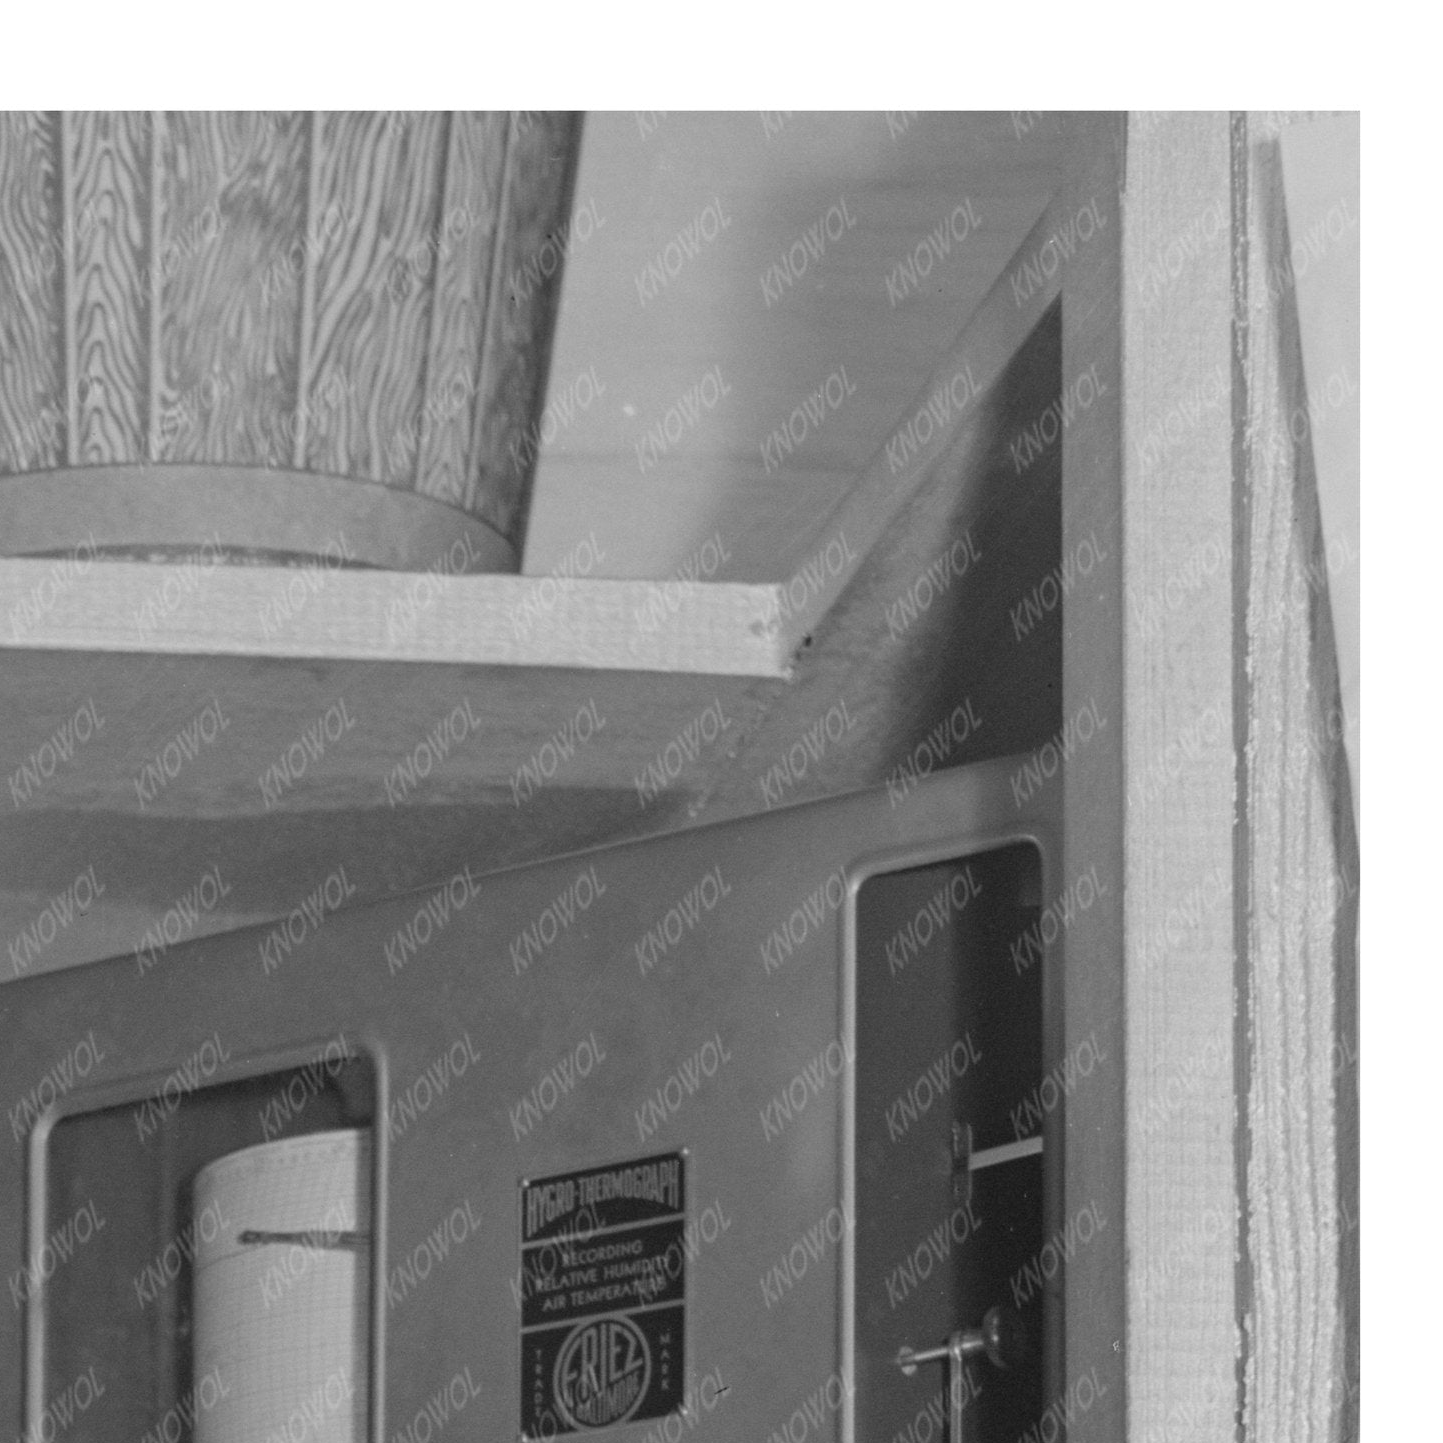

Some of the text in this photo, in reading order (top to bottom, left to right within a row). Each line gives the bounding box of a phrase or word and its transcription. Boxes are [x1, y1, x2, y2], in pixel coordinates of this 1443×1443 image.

[526, 1158, 681, 1239] HYGRO-THERMOGRAPH
[561, 1239, 643, 1268] RECORDING
[534, 1255, 672, 1293] RELATIVE HUMIDITY
[541, 1276, 665, 1313] AIR TEMPERATURE
[561, 1322, 645, 1409] FRIEZ
